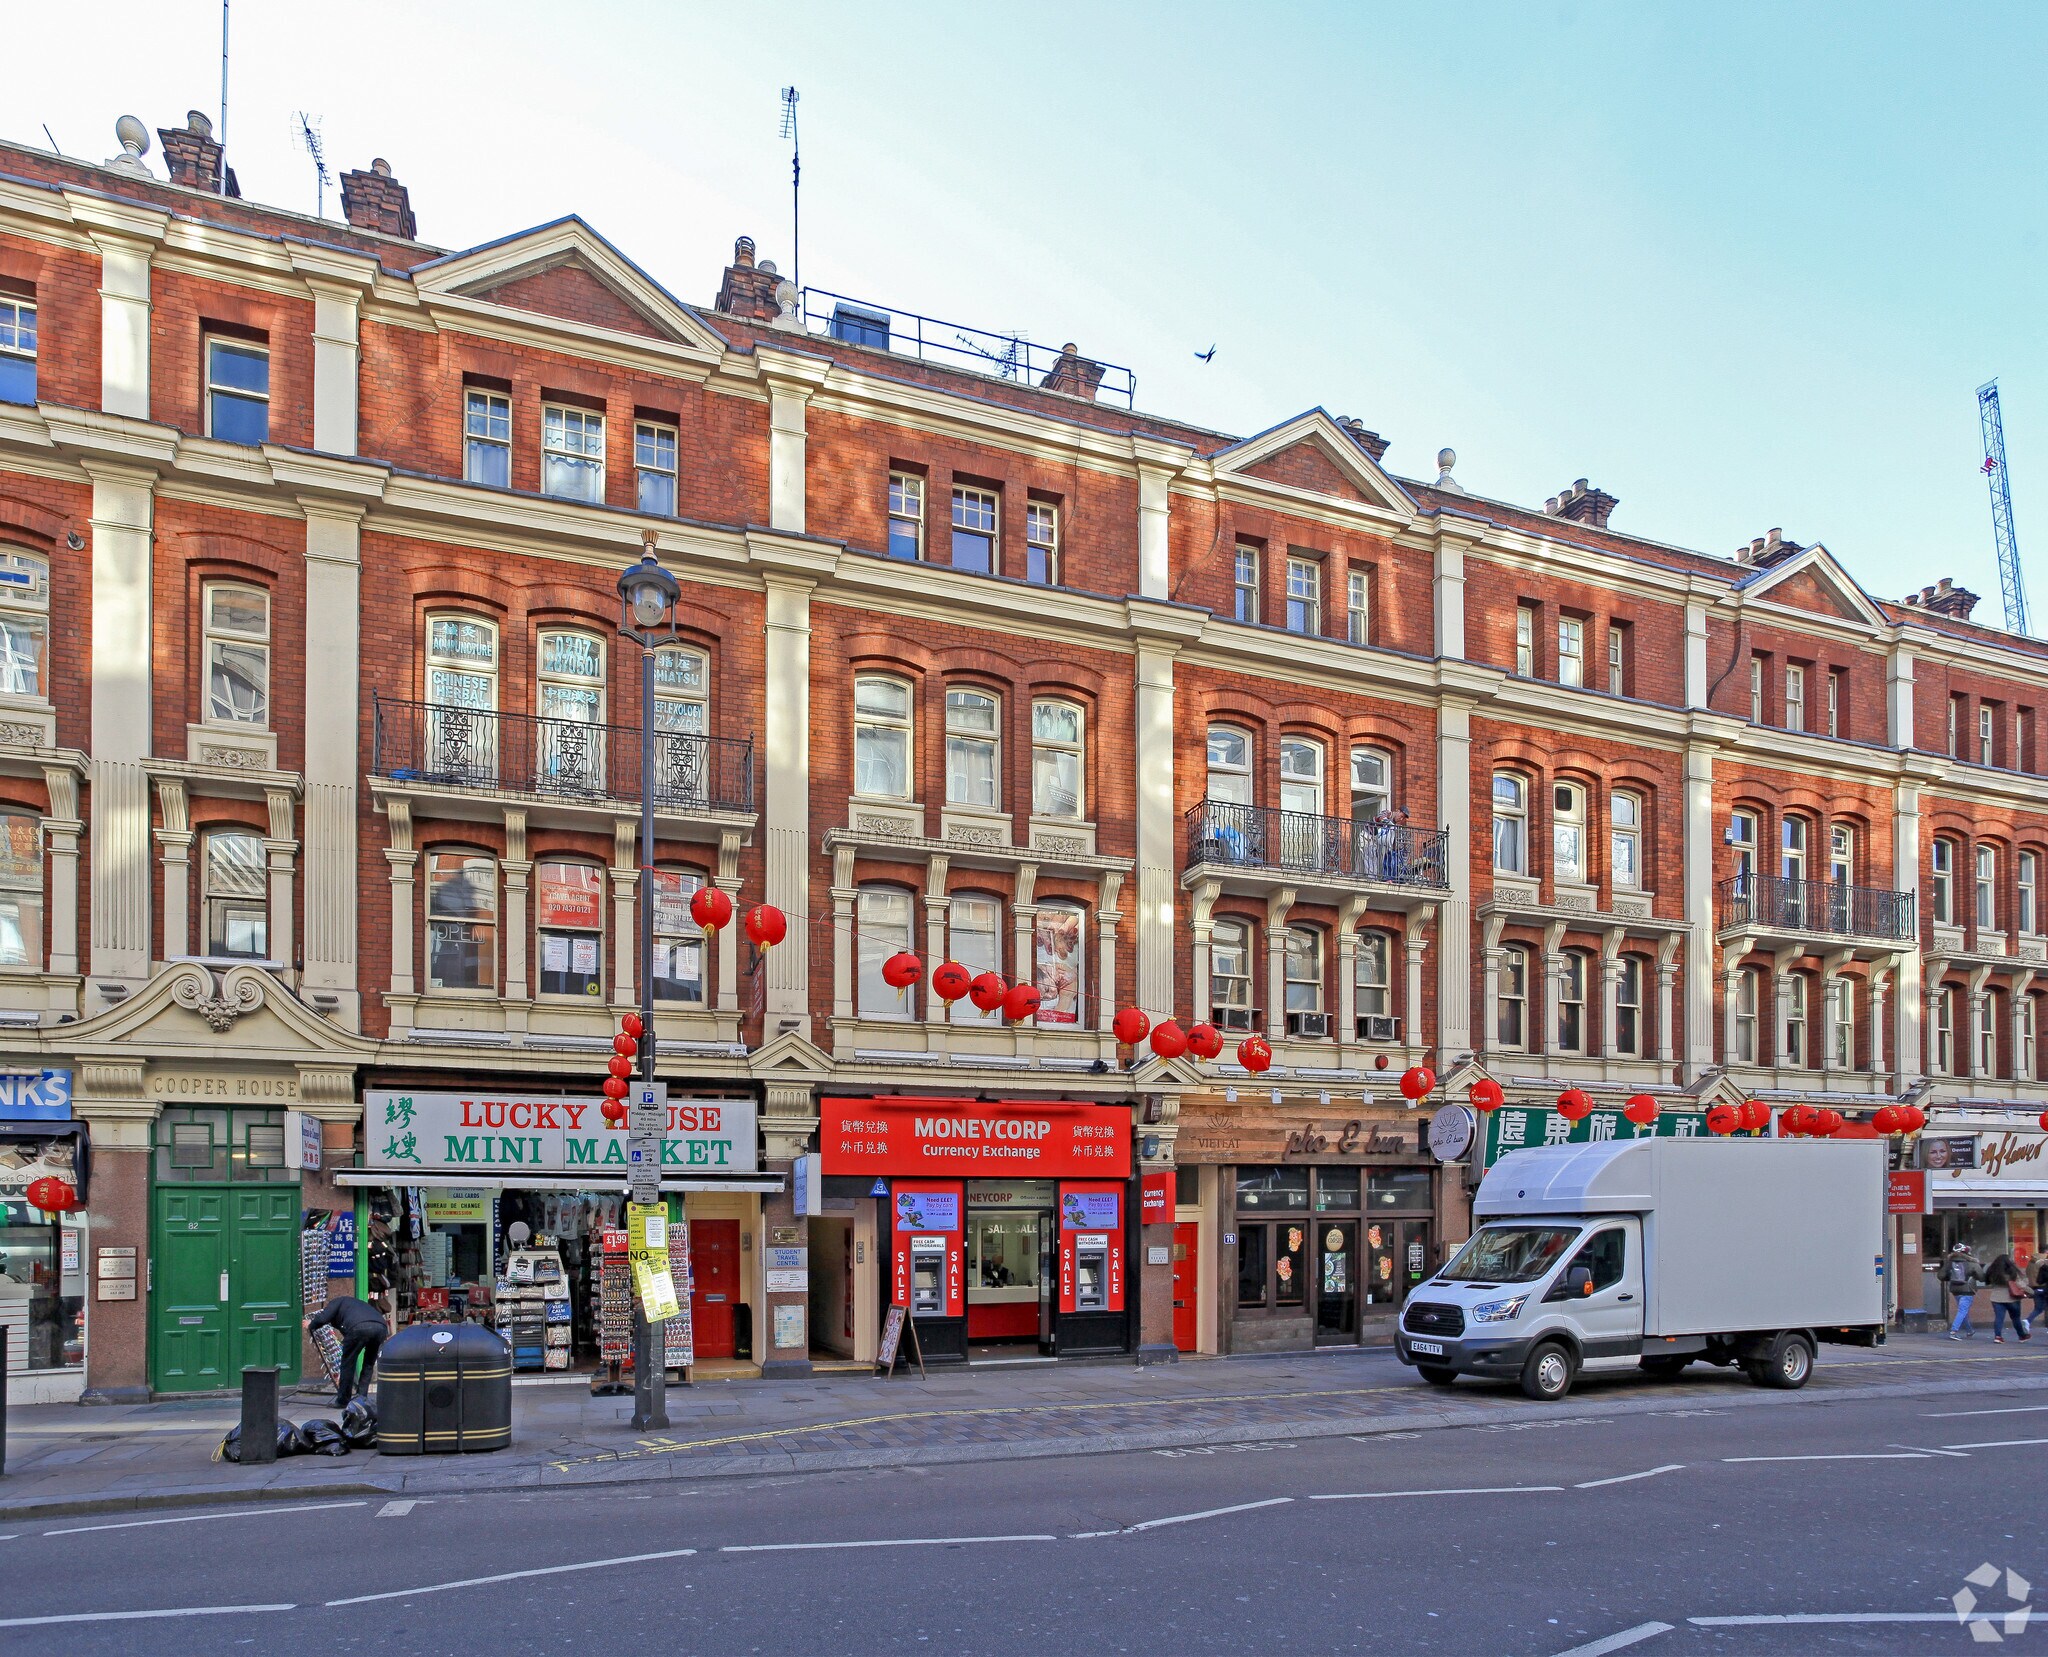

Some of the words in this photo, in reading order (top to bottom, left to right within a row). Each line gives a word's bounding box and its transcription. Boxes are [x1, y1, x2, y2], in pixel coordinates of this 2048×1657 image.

[433, 671, 488, 690] CHINESE
[437, 684, 484, 701] HERBAL
[654, 701, 702, 718] EFLEXOLOGY
[577, 905, 591, 913] 0121
[437, 924, 483, 942] OPEN
[154, 1077, 228, 1095] COOPER
[237, 1079, 297, 1097] HOUSE
[645, 1092, 652, 1102] P
[460, 1100, 588, 1130] LUCKY
[914, 1117, 1051, 1140] MONEYCORP
[1282, 1123, 1330, 1161] pho
[1339, 1119, 1362, 1154] &
[1365, 1124, 1408, 1154] bun
[1432, 1139, 1444, 1148] pho
[1453, 1134, 1464, 1143] bun
[443, 1135, 543, 1164] MINI
[565, 1138, 732, 1165] MAKET
[922, 1144, 980, 1159] Currency
[982, 1145, 1041, 1159] Exchange
[968, 1193, 1013, 1203] NEYCORP
[1144, 1189, 1164, 1198] Currency
[1143, 1199, 1165, 1208] Exchange
[988, 1224, 1010, 1234] SALE
[1015, 1224, 1038, 1234] SALE
[606, 1234, 627, 1248] £1.99
[1226, 1235, 1234, 1243] 76
[331, 1250, 353, 1258] ange
[630, 1251, 649, 1260] NO
[897, 1252, 905, 1300] SALE
[950, 1251, 958, 1299] SALE
[1413, 1342, 1427, 1351] EA64
[1429, 1344, 1440, 1353] TTV
